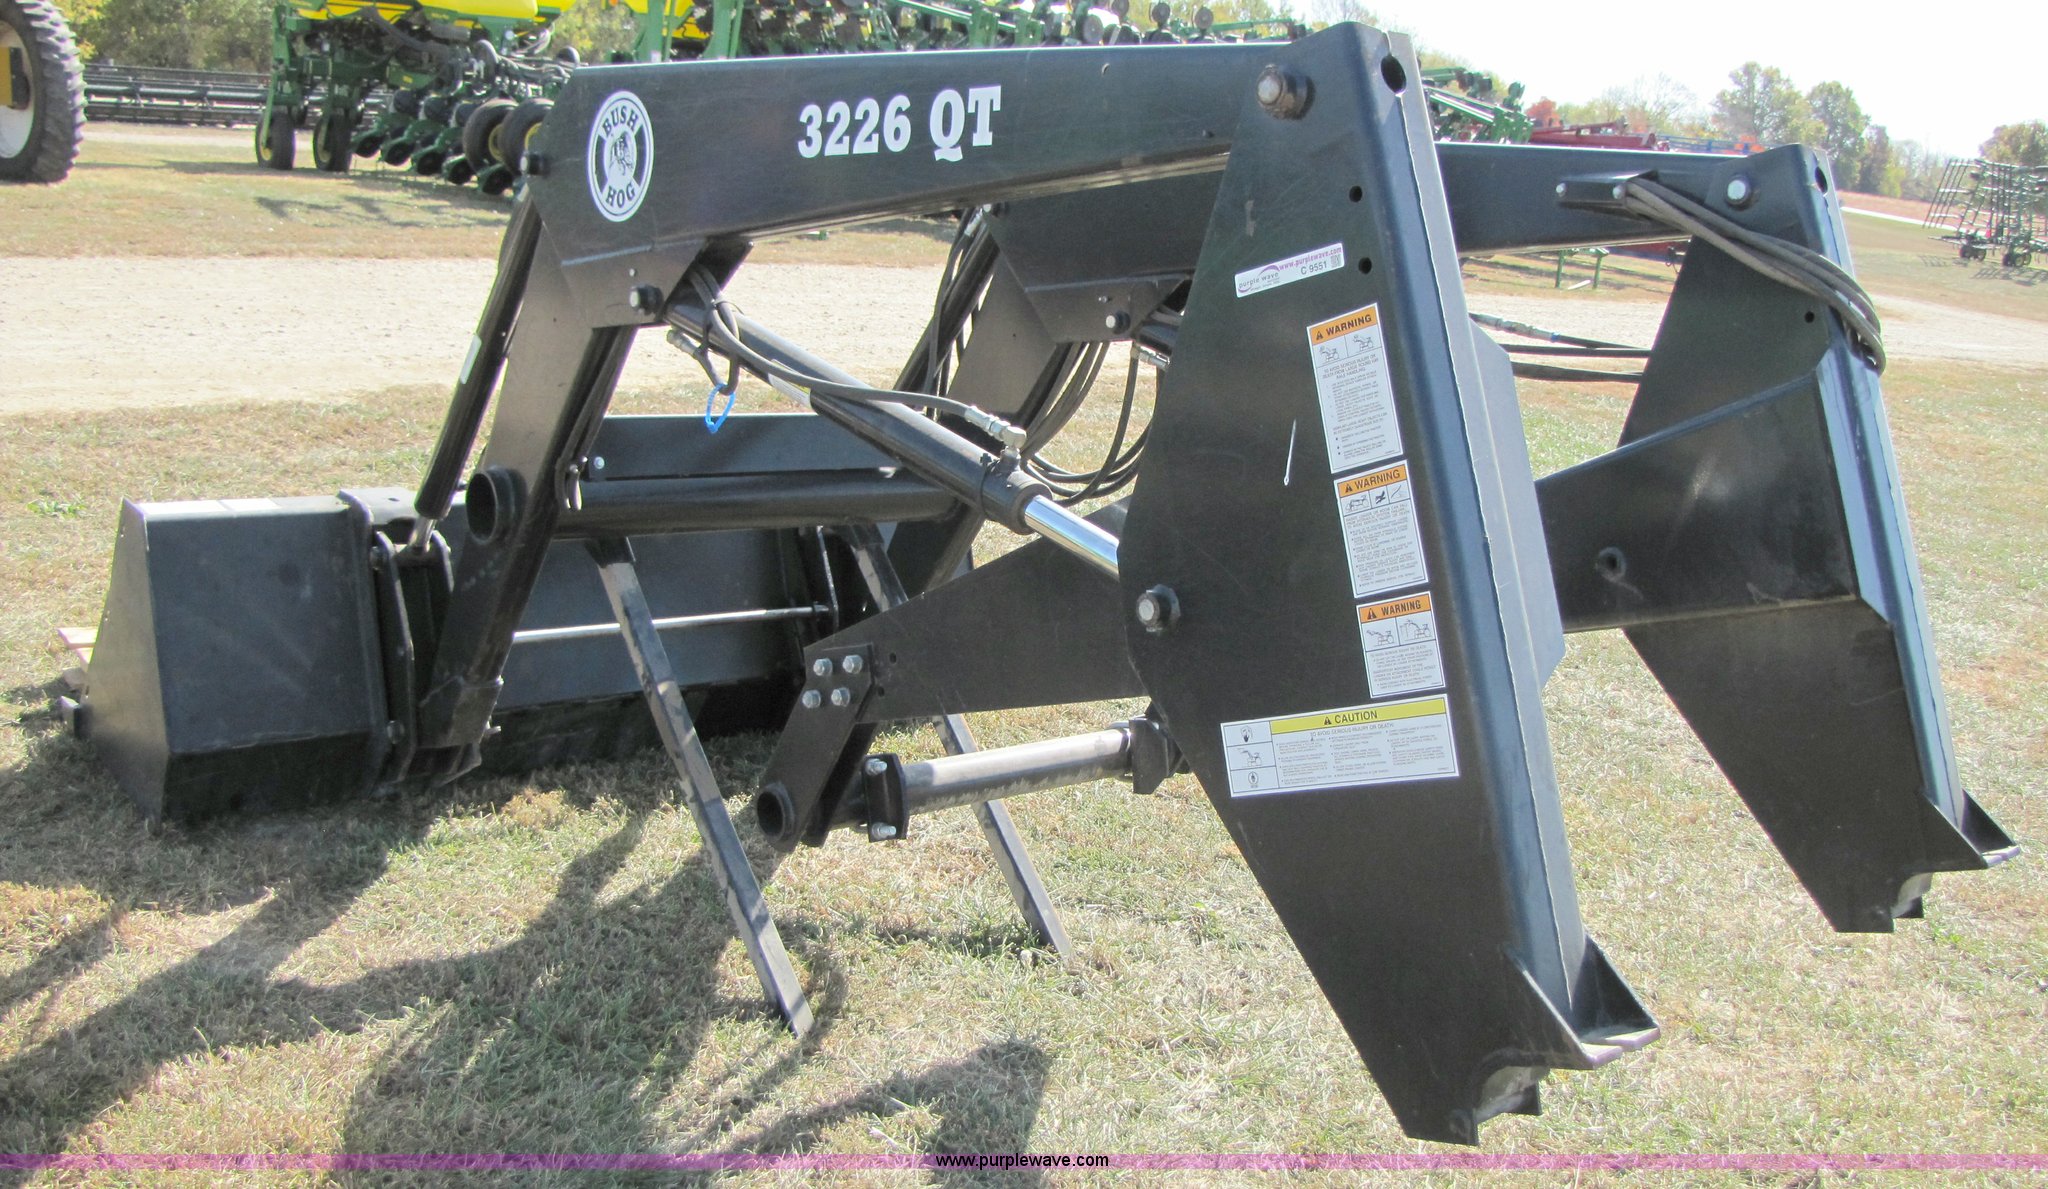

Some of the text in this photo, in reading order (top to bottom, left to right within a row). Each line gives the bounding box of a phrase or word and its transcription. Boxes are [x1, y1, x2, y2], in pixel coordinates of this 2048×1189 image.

[602, 105, 639, 137] BUSH
[798, 85, 1001, 162] 3226 QT
[606, 183, 635, 208] HOG
[1280, 247, 1342, 271] www.purplewave.com
[1300, 261, 1327, 275] C 9551
[1239, 278, 1260, 288] purple
[1261, 272, 1279, 281] wave
[1326, 314, 1372, 336] WARNING
[1355, 469, 1400, 490] WARNING
[1381, 600, 1421, 616] WARNING
[1334, 710, 1377, 724] CAUTION
